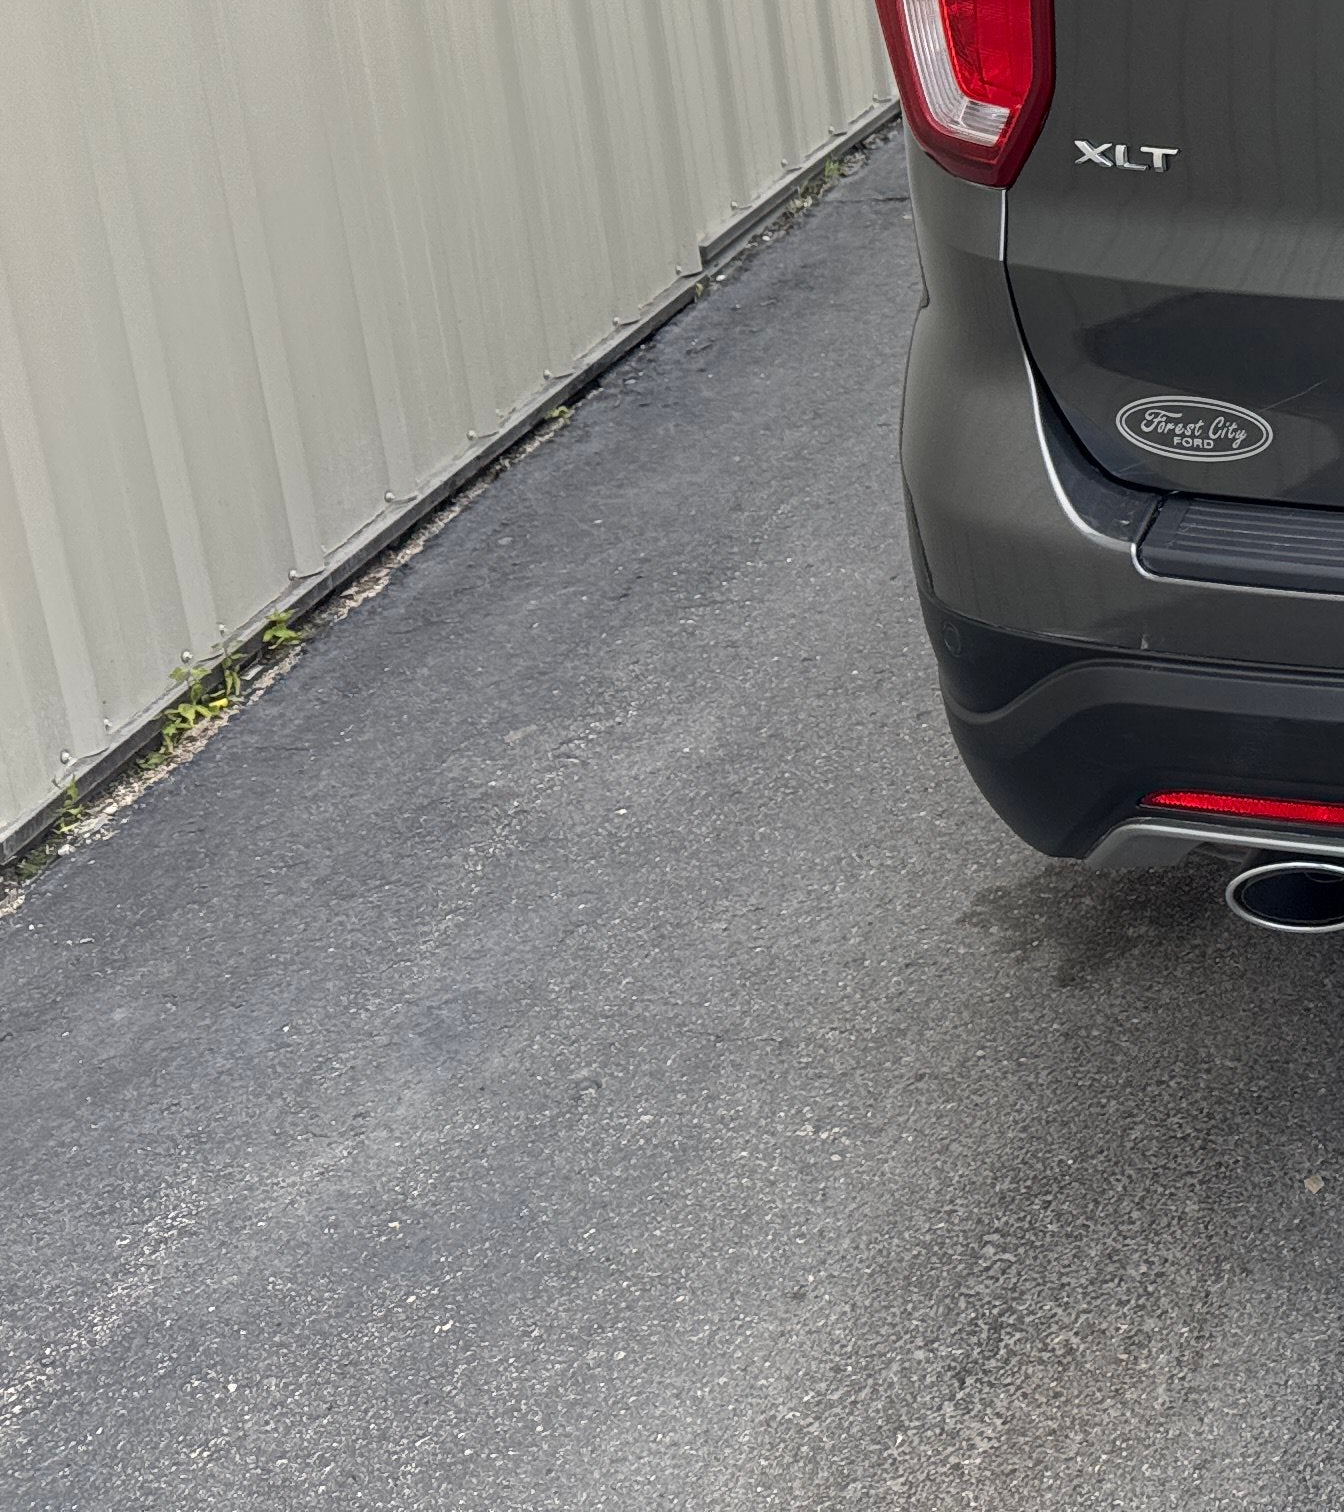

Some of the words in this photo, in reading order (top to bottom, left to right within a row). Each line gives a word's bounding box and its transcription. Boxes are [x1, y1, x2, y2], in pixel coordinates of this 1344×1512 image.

[1073, 140, 1179, 173] XLT
[1140, 409, 1203, 437] Forest
[1208, 416, 1247, 449] City
[1173, 437, 1214, 449] FORD
